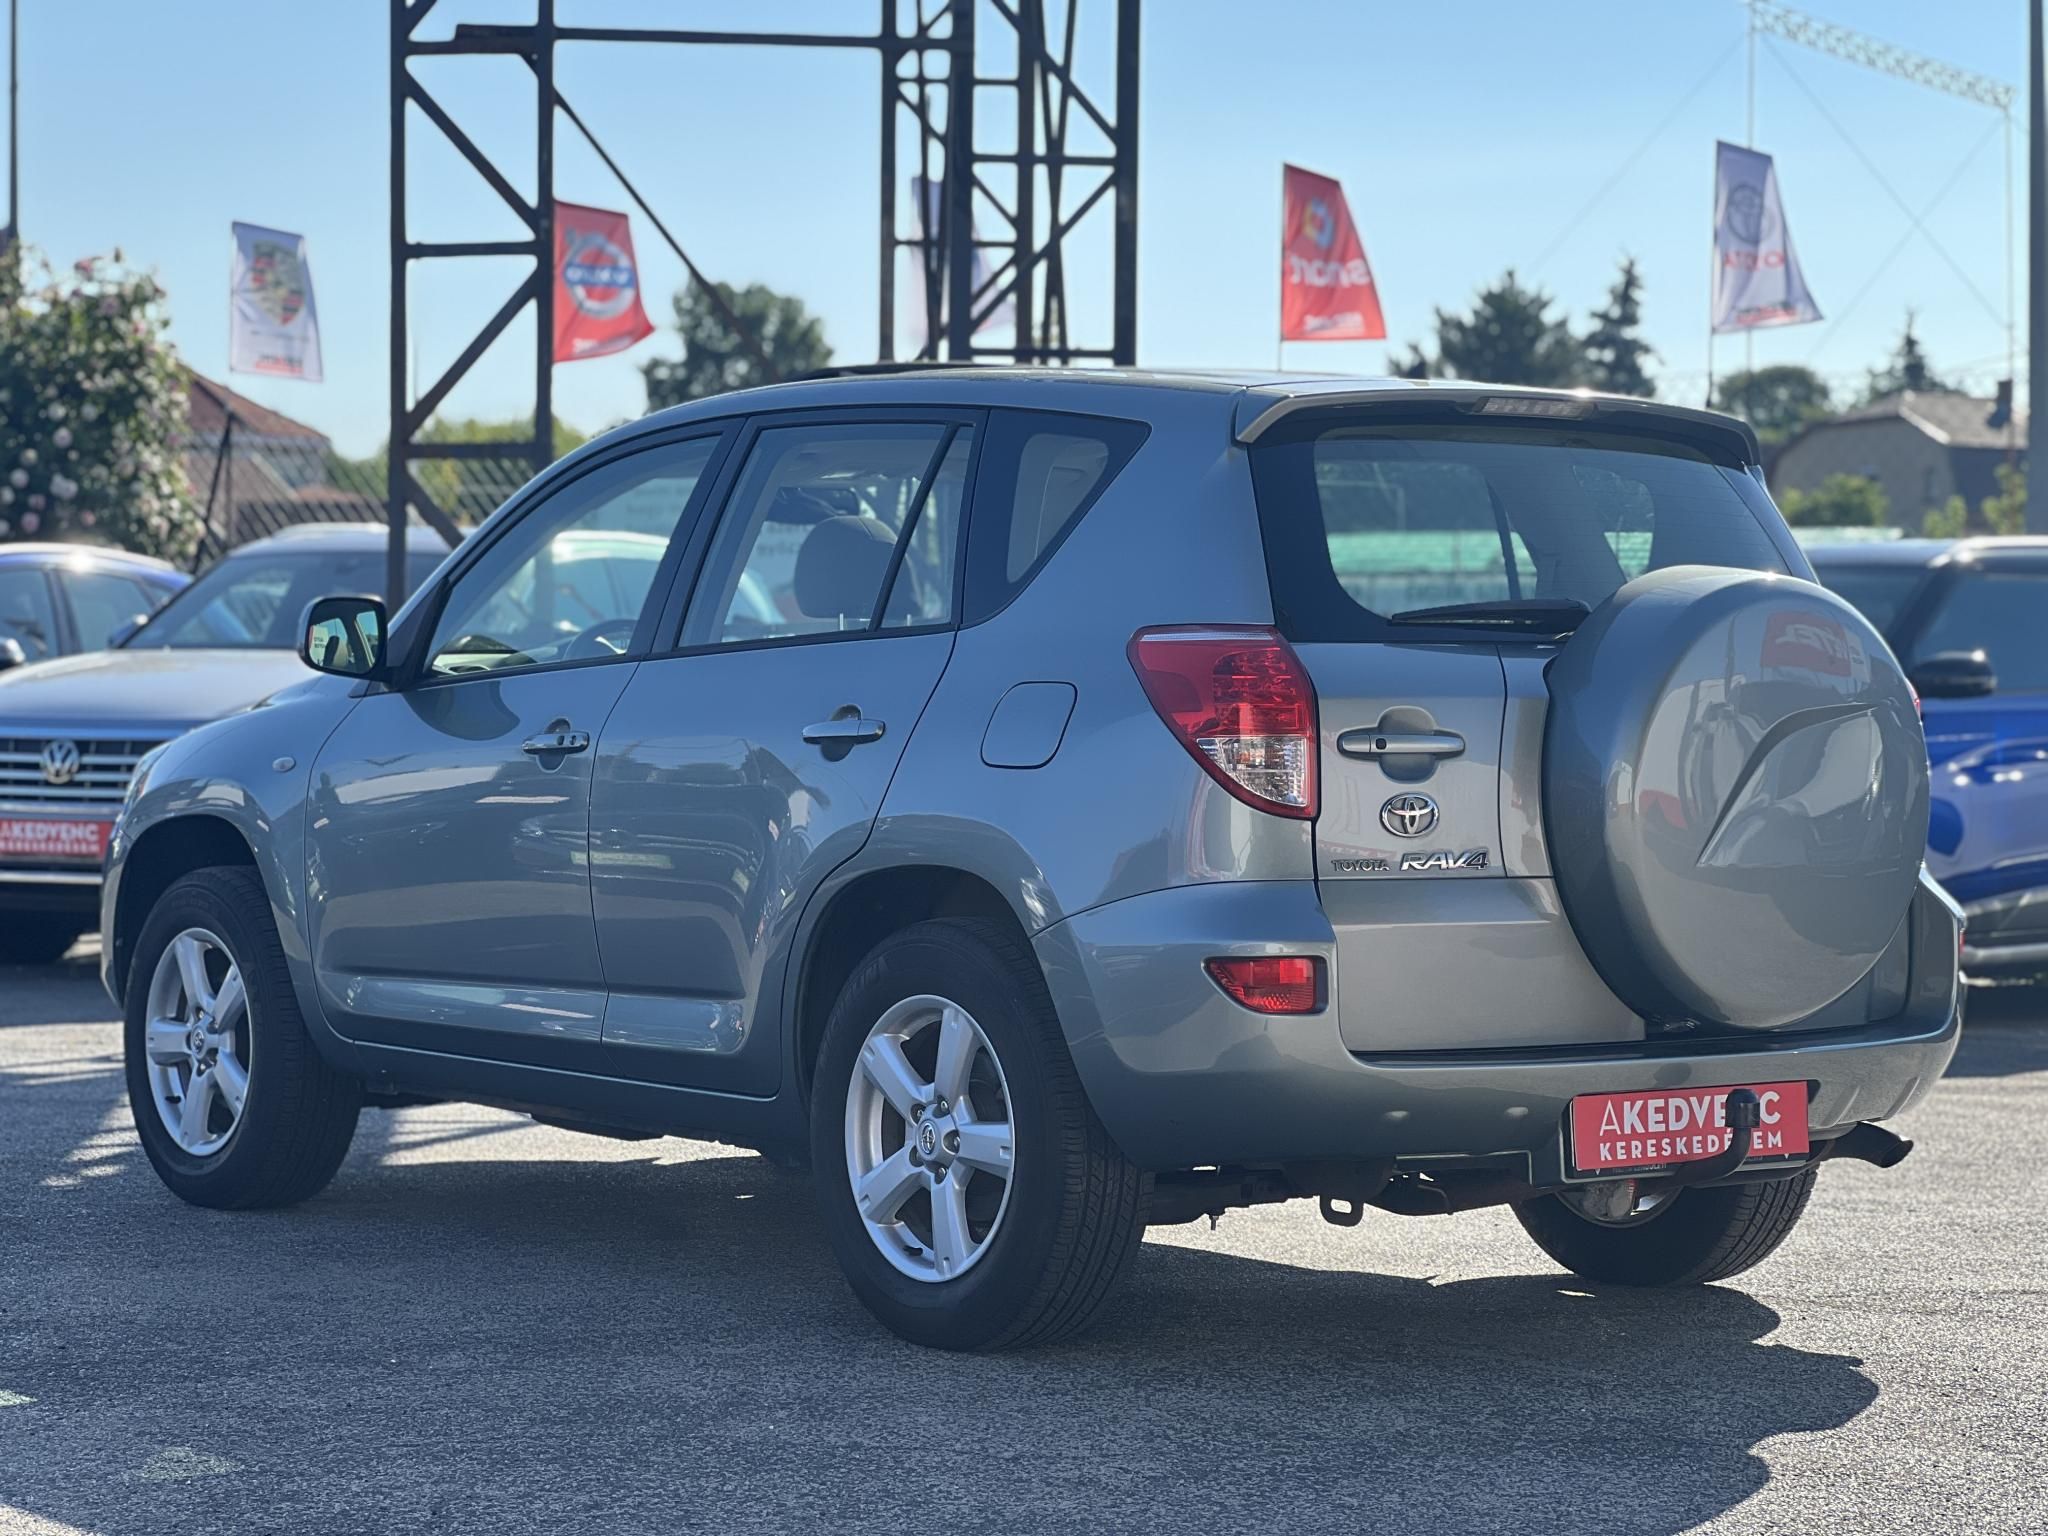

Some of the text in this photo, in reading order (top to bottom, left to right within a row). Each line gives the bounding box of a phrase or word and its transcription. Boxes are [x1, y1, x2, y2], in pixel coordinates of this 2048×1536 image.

[1332, 859, 1390, 871] TOYOTA
[1400, 848, 1489, 871] RAV4
[1599, 1091, 1782, 1137] AKEDVEC
[1600, 1128, 1783, 1161] KERESKEDÉEM
